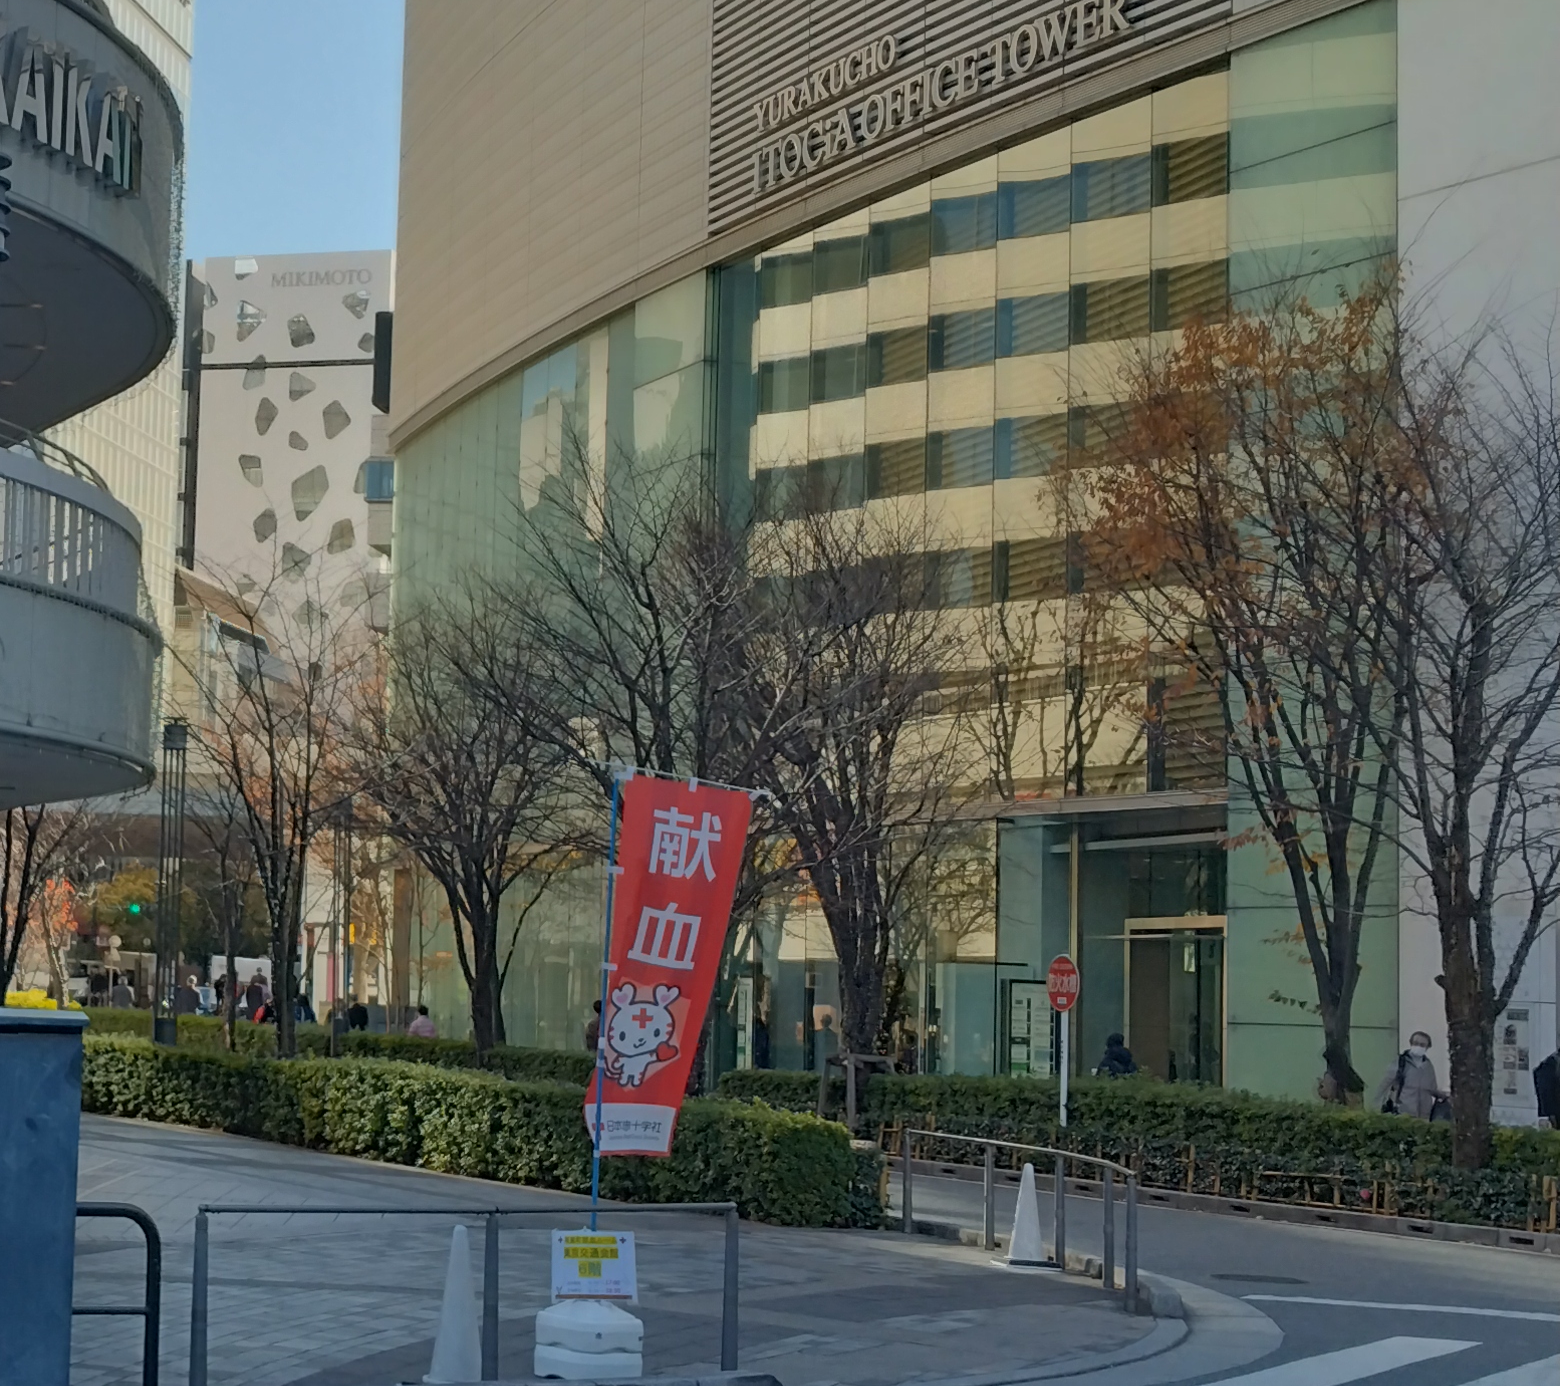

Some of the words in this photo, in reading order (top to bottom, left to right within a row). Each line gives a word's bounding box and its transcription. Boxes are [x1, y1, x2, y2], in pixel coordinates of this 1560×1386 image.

[753, 34, 899, 133] YURAKUCHO
[862, 48, 978, 141] OFFICE
[271, 268, 372, 287] MIKIMOTO
[627, 806, 723, 970] 献血
